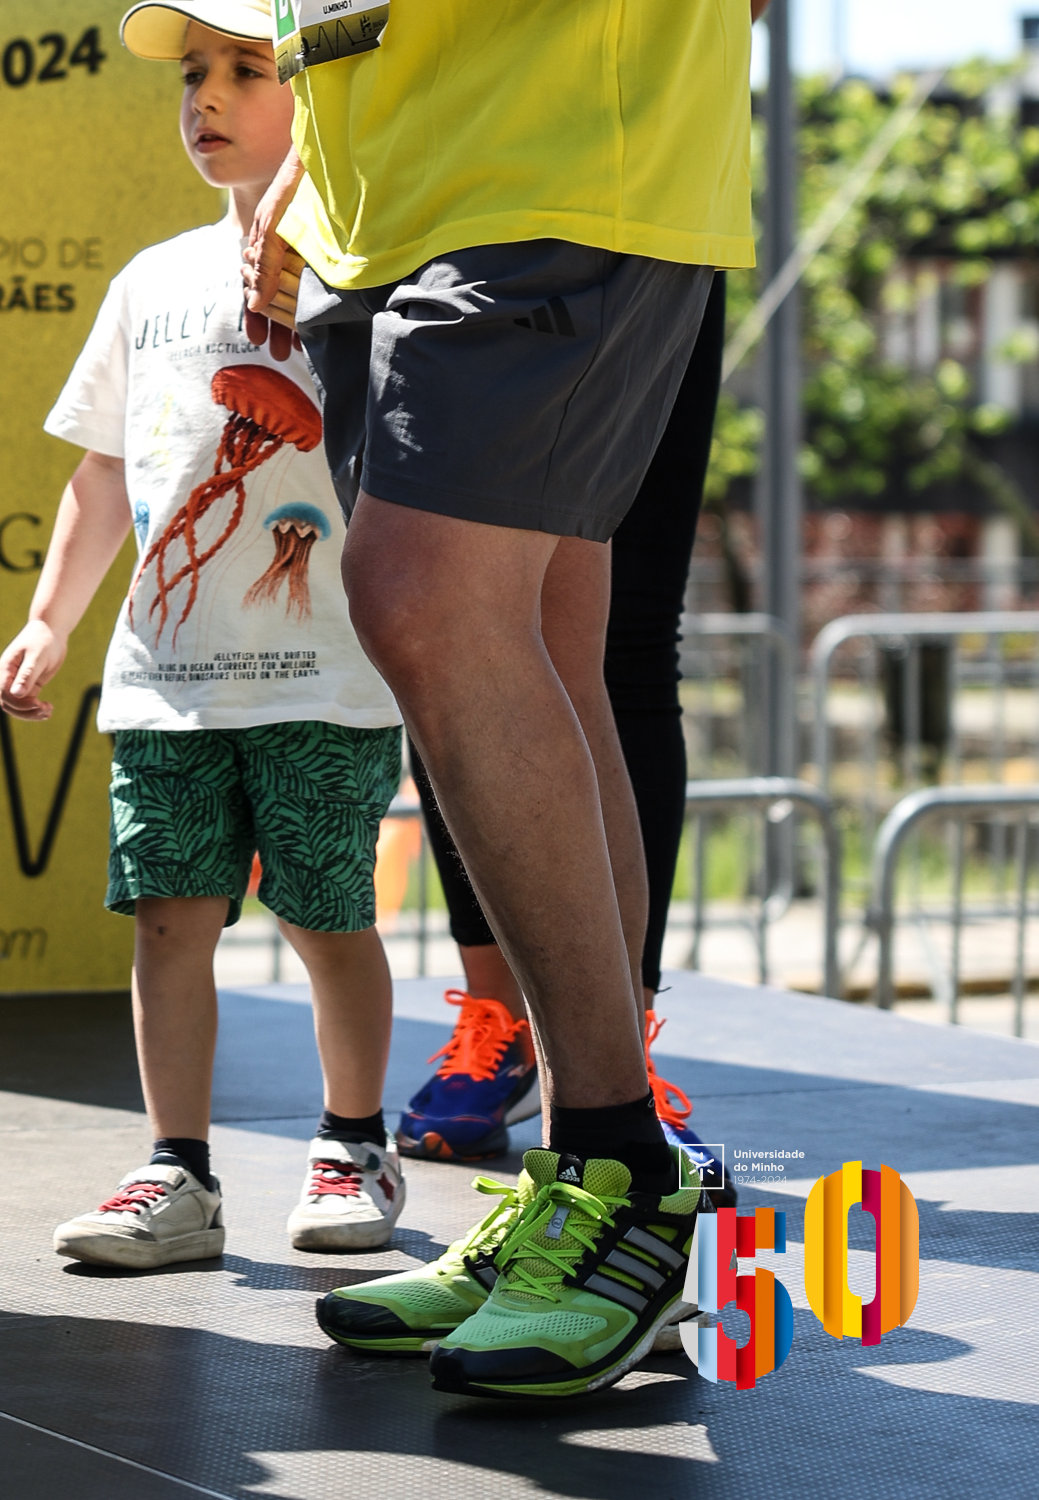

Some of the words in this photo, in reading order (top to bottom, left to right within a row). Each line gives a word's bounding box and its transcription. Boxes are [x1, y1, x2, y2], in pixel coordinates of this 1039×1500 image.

[58, 237, 105, 269] DE
[135, 301, 217, 350] JELLY
[214, 651, 254, 661] JELLYFISH
[258, 651, 280, 660] HAVE
[284, 650, 316, 660] DRIFTED
[190, 663, 214, 671] OCEAN
[217, 661, 258, 670] CURRENTS
[262, 661, 276, 670] FOR
[280, 660, 315, 669] MILLIONS
[189, 671, 229, 681] DINOSAURS
[234, 671, 256, 680] LIVED
[260, 671, 270, 679] ON
[275, 670, 289, 679] THE
[293, 669, 320, 679] EARTH
[558, 1174, 580, 1183] adidas
